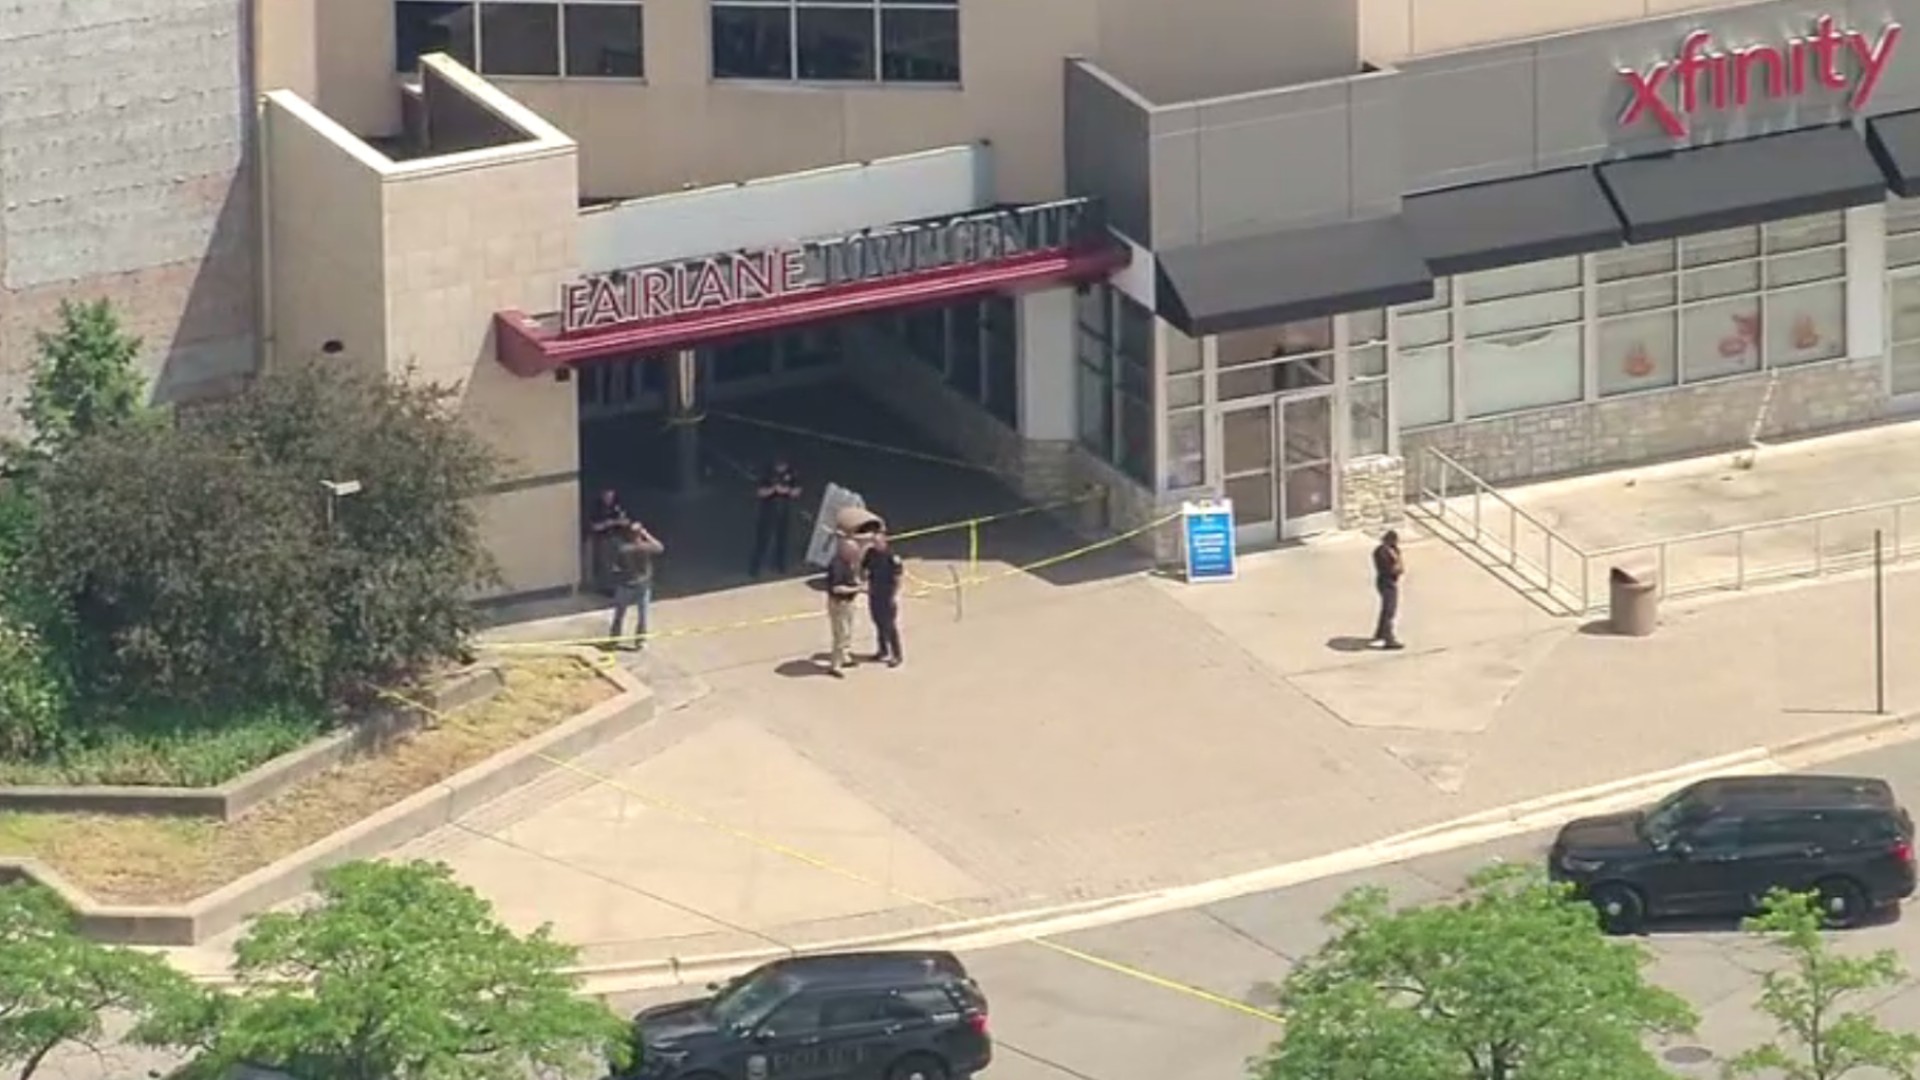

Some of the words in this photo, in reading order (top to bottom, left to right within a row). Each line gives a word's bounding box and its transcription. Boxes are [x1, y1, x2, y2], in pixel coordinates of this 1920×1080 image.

[1617, 14, 1901, 138] xfinity
[563, 247, 805, 331] FAIRLANE
[814, 222, 948, 286] TOWN
